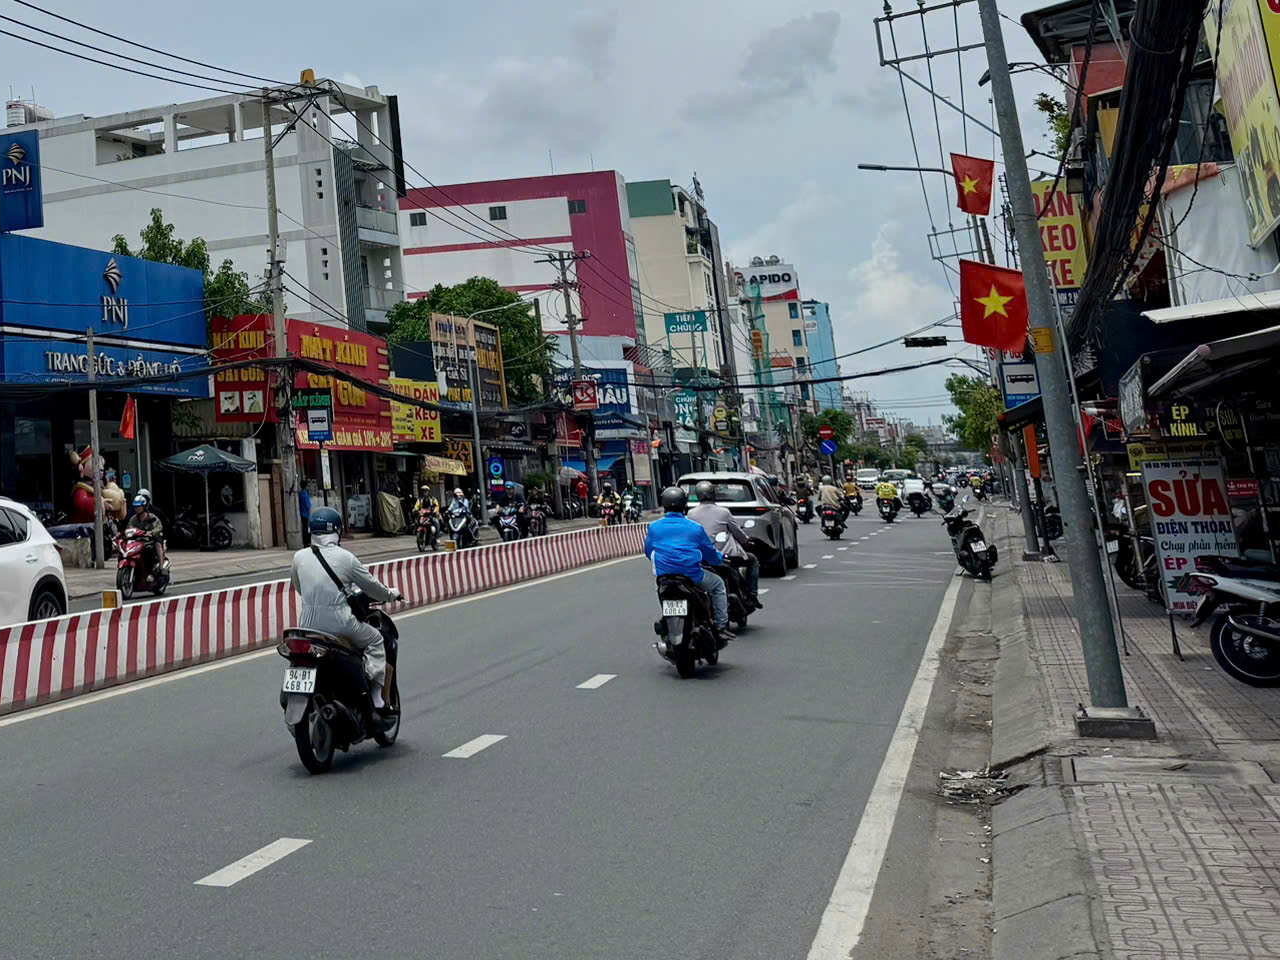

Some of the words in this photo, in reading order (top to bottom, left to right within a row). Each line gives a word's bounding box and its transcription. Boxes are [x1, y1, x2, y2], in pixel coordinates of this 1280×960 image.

[2, 164, 32, 188] PNJ
[101, 295, 129, 329] PNJ
[413, 384, 437, 401] DÁN
[1171, 403, 1189, 420] ÉP
[420, 426, 435, 440] XE
[1170, 420, 1198, 436] KÍNH
[1148, 470, 1229, 517] SỬA
[1156, 519, 1189, 537] ĐIỆN
[1191, 520, 1233, 537] THOẠI
[1164, 555, 1188, 571] ÉP
